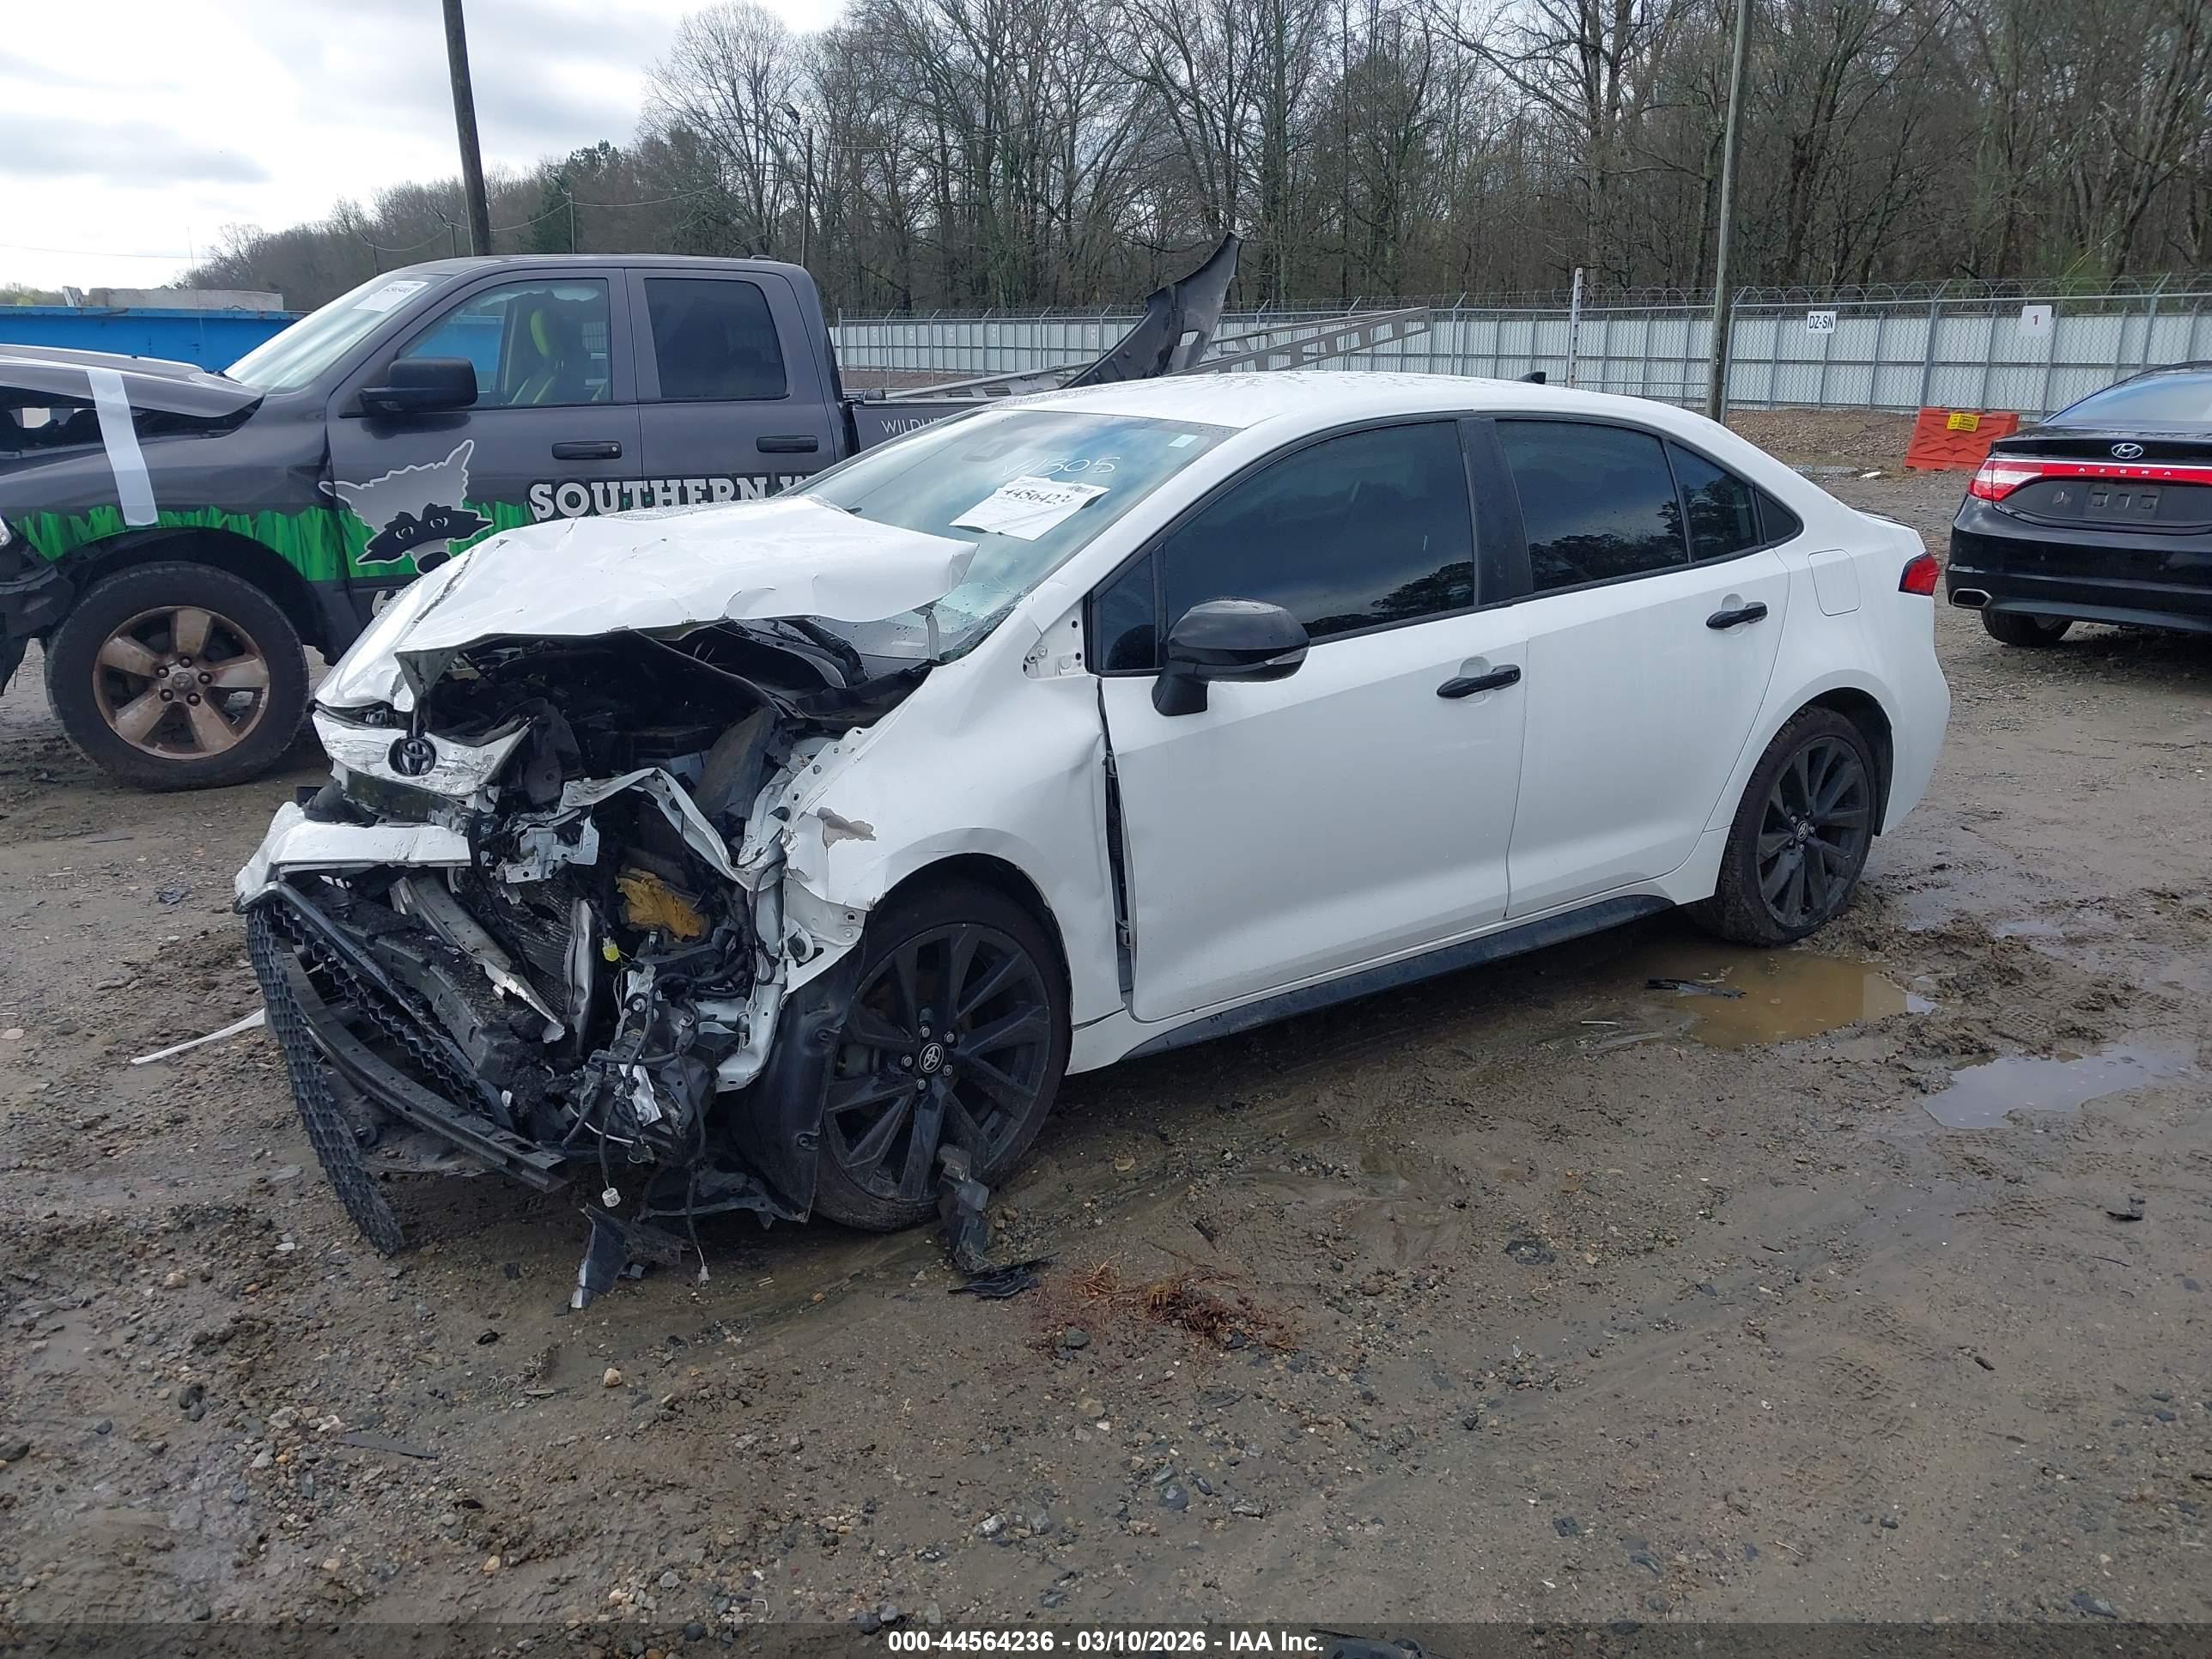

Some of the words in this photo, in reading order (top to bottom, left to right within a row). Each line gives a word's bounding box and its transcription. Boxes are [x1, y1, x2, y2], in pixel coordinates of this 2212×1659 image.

[1808, 315, 1834, 329] DZ-SN
[2033, 314, 2039, 325] 1
[2078, 467, 2172, 476] AZERA
[529, 477, 768, 520] SOUTHERN
